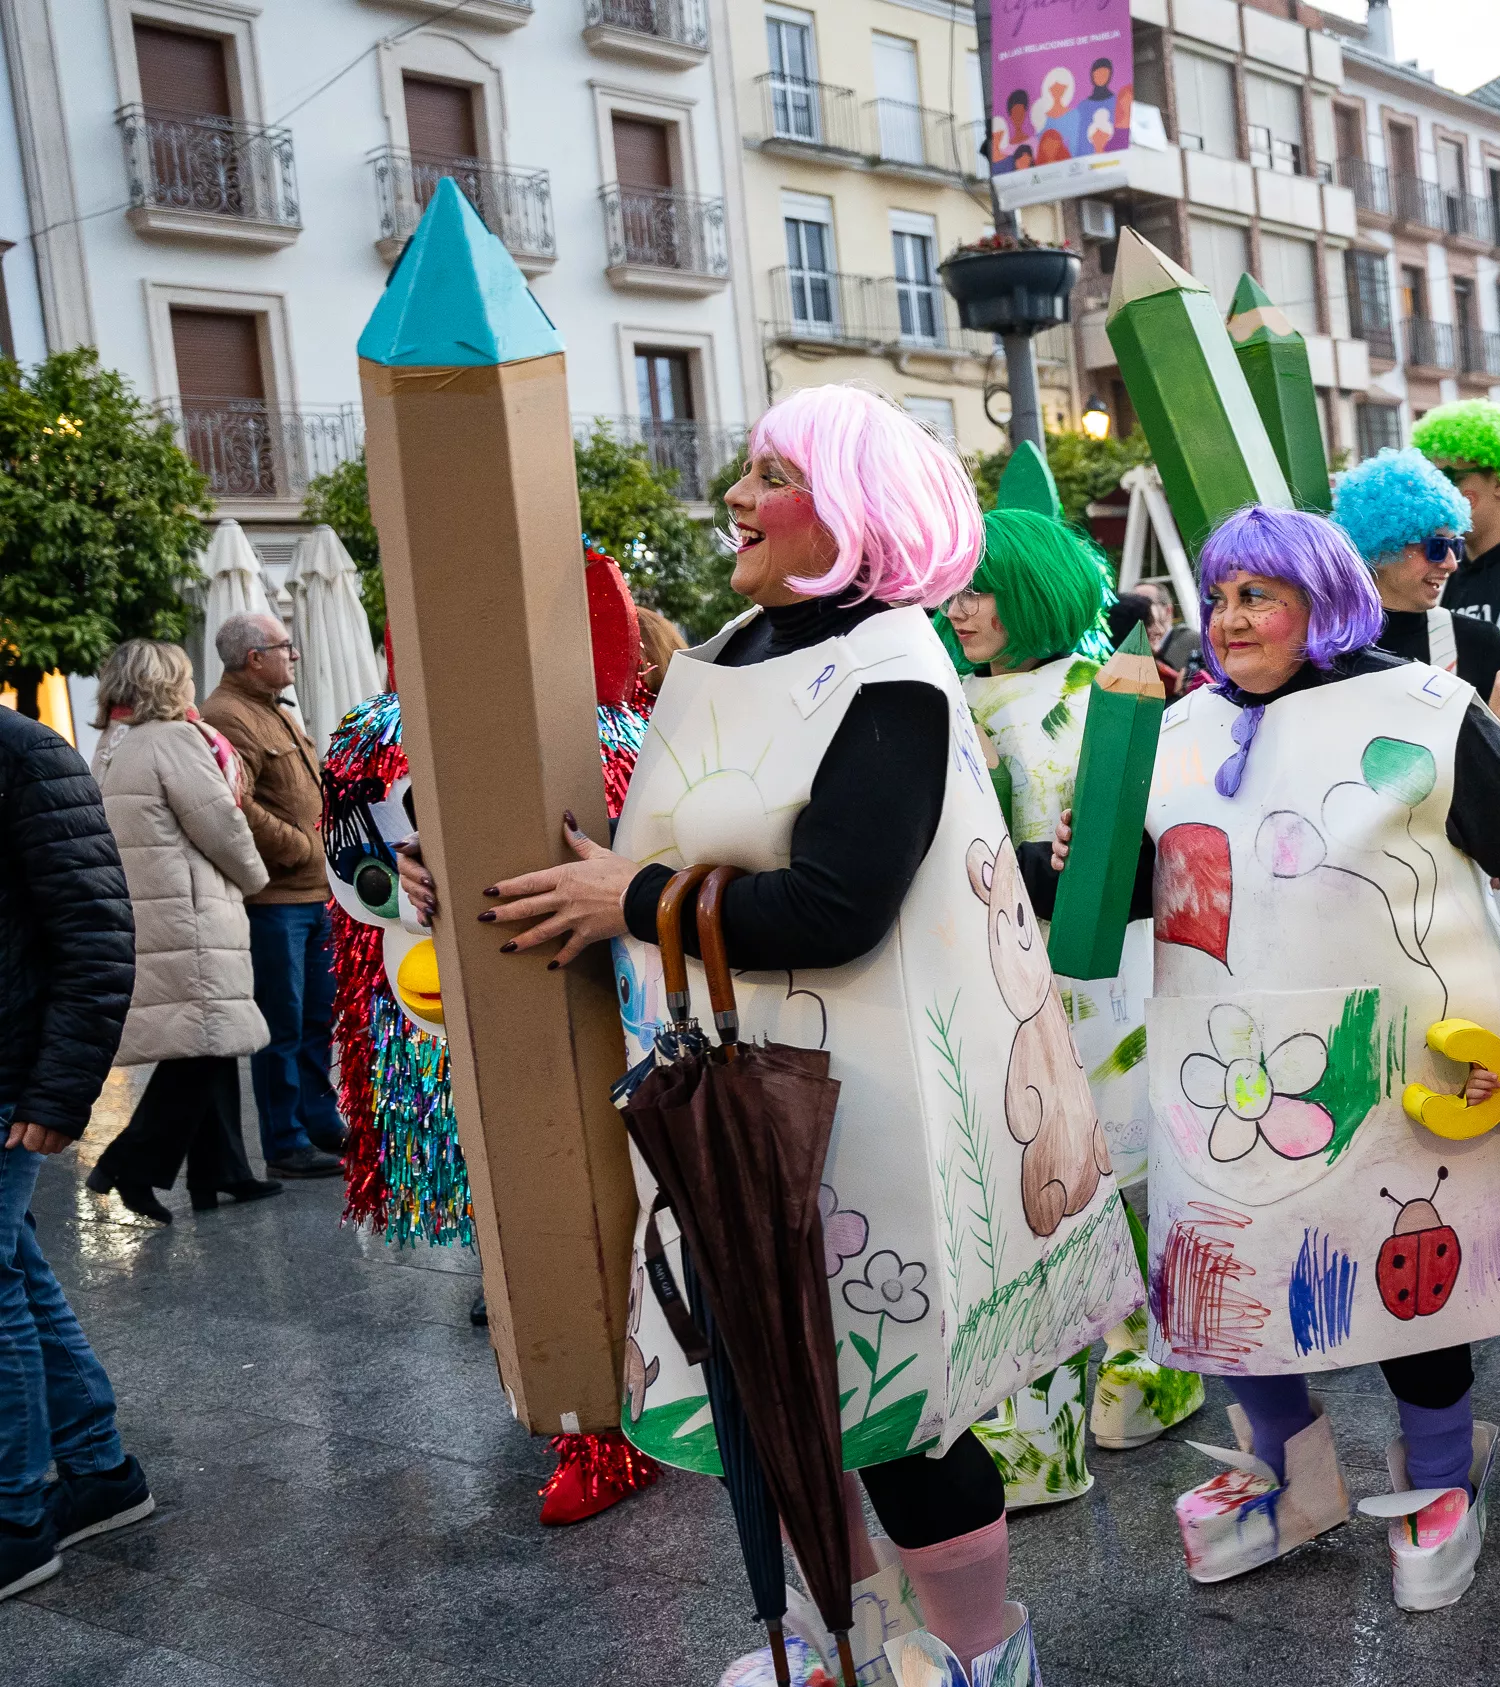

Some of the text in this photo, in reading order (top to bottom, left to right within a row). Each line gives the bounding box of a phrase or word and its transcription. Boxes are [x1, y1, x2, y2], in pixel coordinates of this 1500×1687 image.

[1025, 38, 1075, 53] RELACIONES
[1076, 36, 1088, 45] DE
[807, 664, 835, 700] R
[1423, 675, 1442, 698] L
